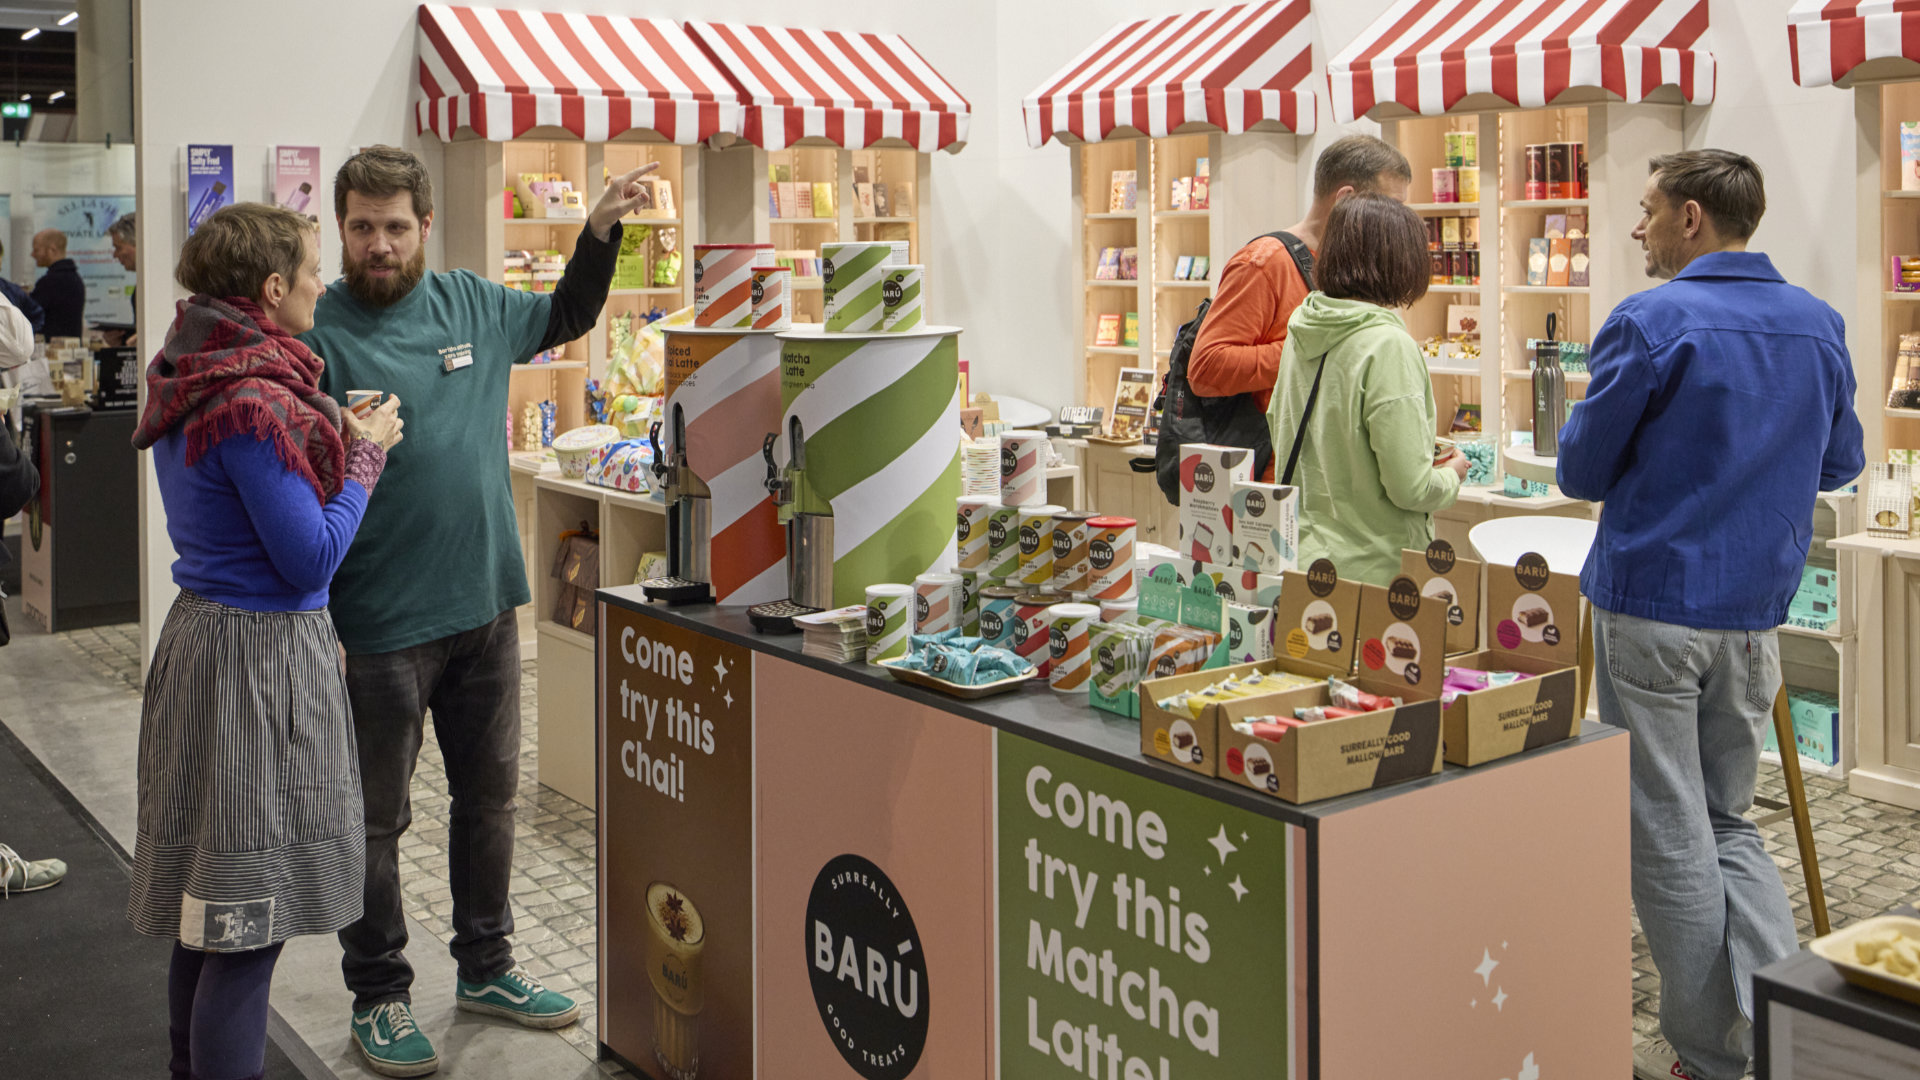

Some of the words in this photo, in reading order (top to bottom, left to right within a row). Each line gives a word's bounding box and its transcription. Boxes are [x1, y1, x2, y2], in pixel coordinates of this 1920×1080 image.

[752, 286, 763, 296] ARÚ
[675, 358, 700, 369] Latte
[783, 353, 810, 365] Matcha
[785, 365, 805, 377] Latte
[1001, 455, 1016, 467] ARÚ
[1194, 470, 1214, 483] BARÚ
[1246, 498, 1265, 509] BARÚ
[957, 522, 969, 533] ARÚ
[1089, 548, 1112, 560] BARÚ
[1427, 548, 1454, 563] BARÚ
[1308, 569, 1335, 584] BARÚ
[1517, 563, 1547, 578] BARÚ
[1154, 573, 1173, 586] BARÚ
[1193, 584, 1212, 597] BARÚ
[1390, 591, 1419, 607] BARÚ
[867, 615, 884, 627] ARÚ
[1015, 627, 1027, 637] ARÚ
[1230, 627, 1242, 640] RÚ
[621, 626, 694, 685] Come
[620, 679, 658, 741] try
[666, 697, 715, 755] this
[1498, 705, 1533, 722] SURREALLY
[1533, 699, 1553, 712] GOOD
[1503, 717, 1531, 731] MALLOW
[1531, 712, 1549, 725] BARS
[1340, 736, 1386, 754] SURREALLY
[1386, 731, 1411, 745] GOOD
[1347, 751, 1383, 765] MALLOW
[1383, 744, 1405, 759] BARS
[621, 740, 684, 802] Chai!
[1026, 765, 1168, 860] Come
[832, 871, 899, 918] SURREALLY
[1025, 838, 1098, 929] try
[1113, 873, 1211, 963] this
[662, 962, 688, 989] BARÚ
[815, 919, 918, 1018] BARÚ
[1027, 918, 1219, 1058] Matcha
[827, 1004, 854, 1049] GOOD
[863, 1044, 905, 1067] TREATS
